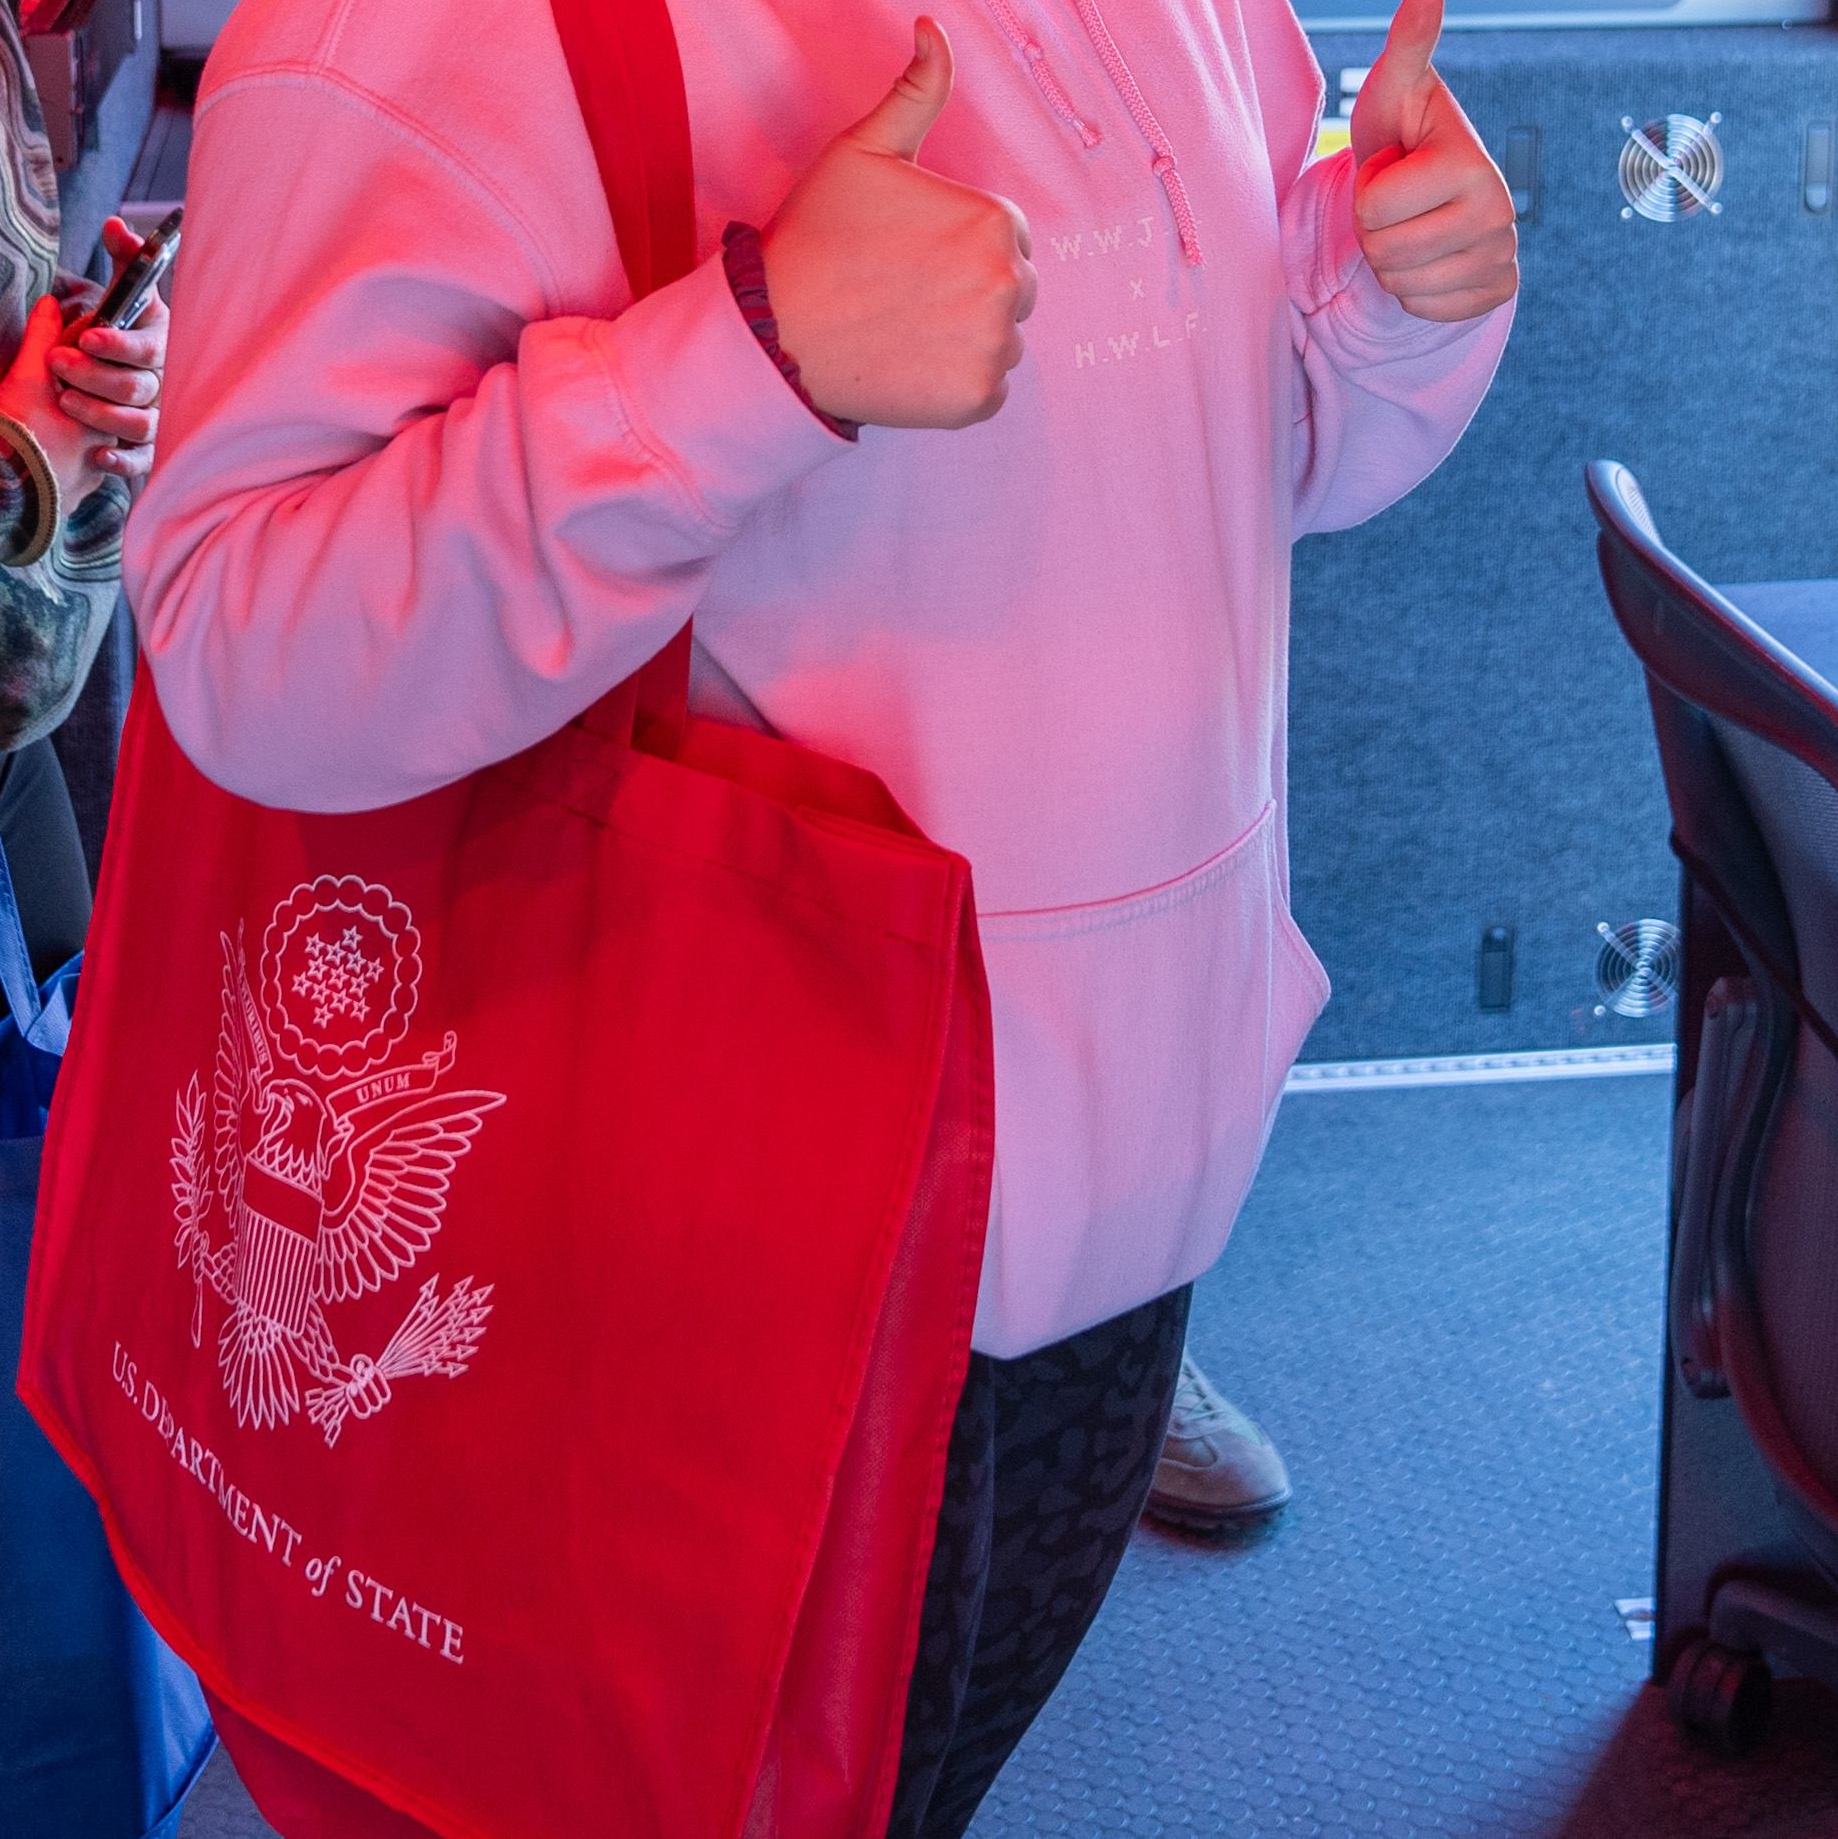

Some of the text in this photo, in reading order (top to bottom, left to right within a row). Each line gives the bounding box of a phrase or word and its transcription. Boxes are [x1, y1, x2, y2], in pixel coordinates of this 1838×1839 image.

[1074, 311, 1209, 370] H.W.L.F.
[355, 1071, 411, 1104] UNUM
[305, 1555, 342, 1597] of
[345, 1569, 465, 1665] STATE
